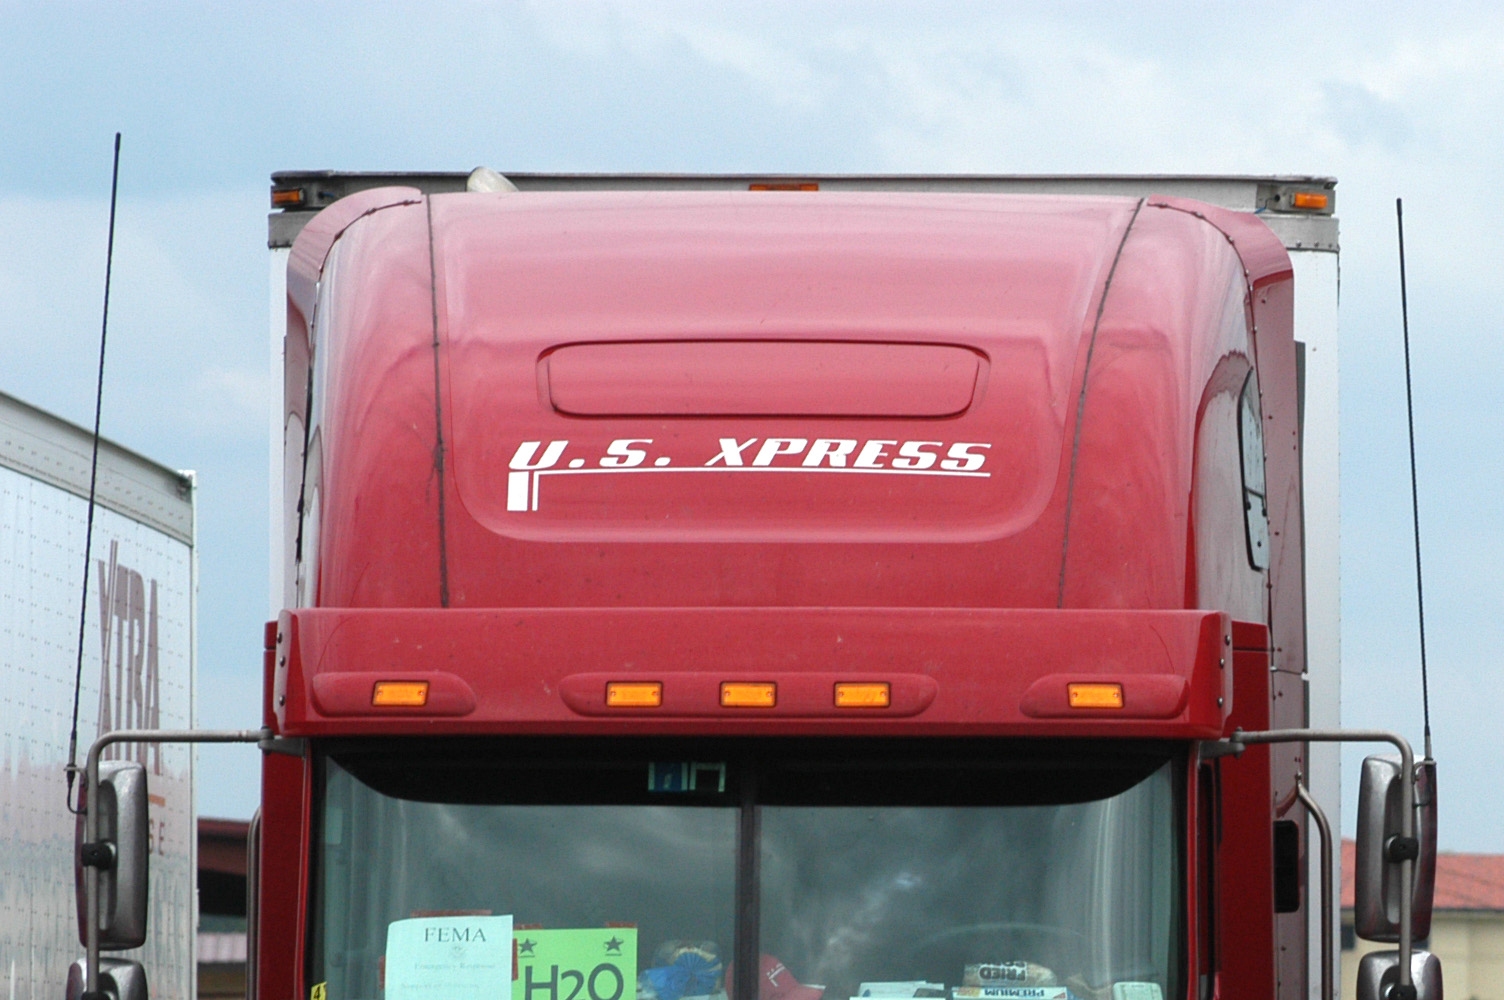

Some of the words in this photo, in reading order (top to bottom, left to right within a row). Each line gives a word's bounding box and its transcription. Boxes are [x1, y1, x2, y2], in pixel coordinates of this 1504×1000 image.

[507, 438, 672, 479] U.S.
[704, 437, 992, 471] XPRESS
[97, 540, 161, 777] XTRA
[423, 927, 487, 944] FEMA
